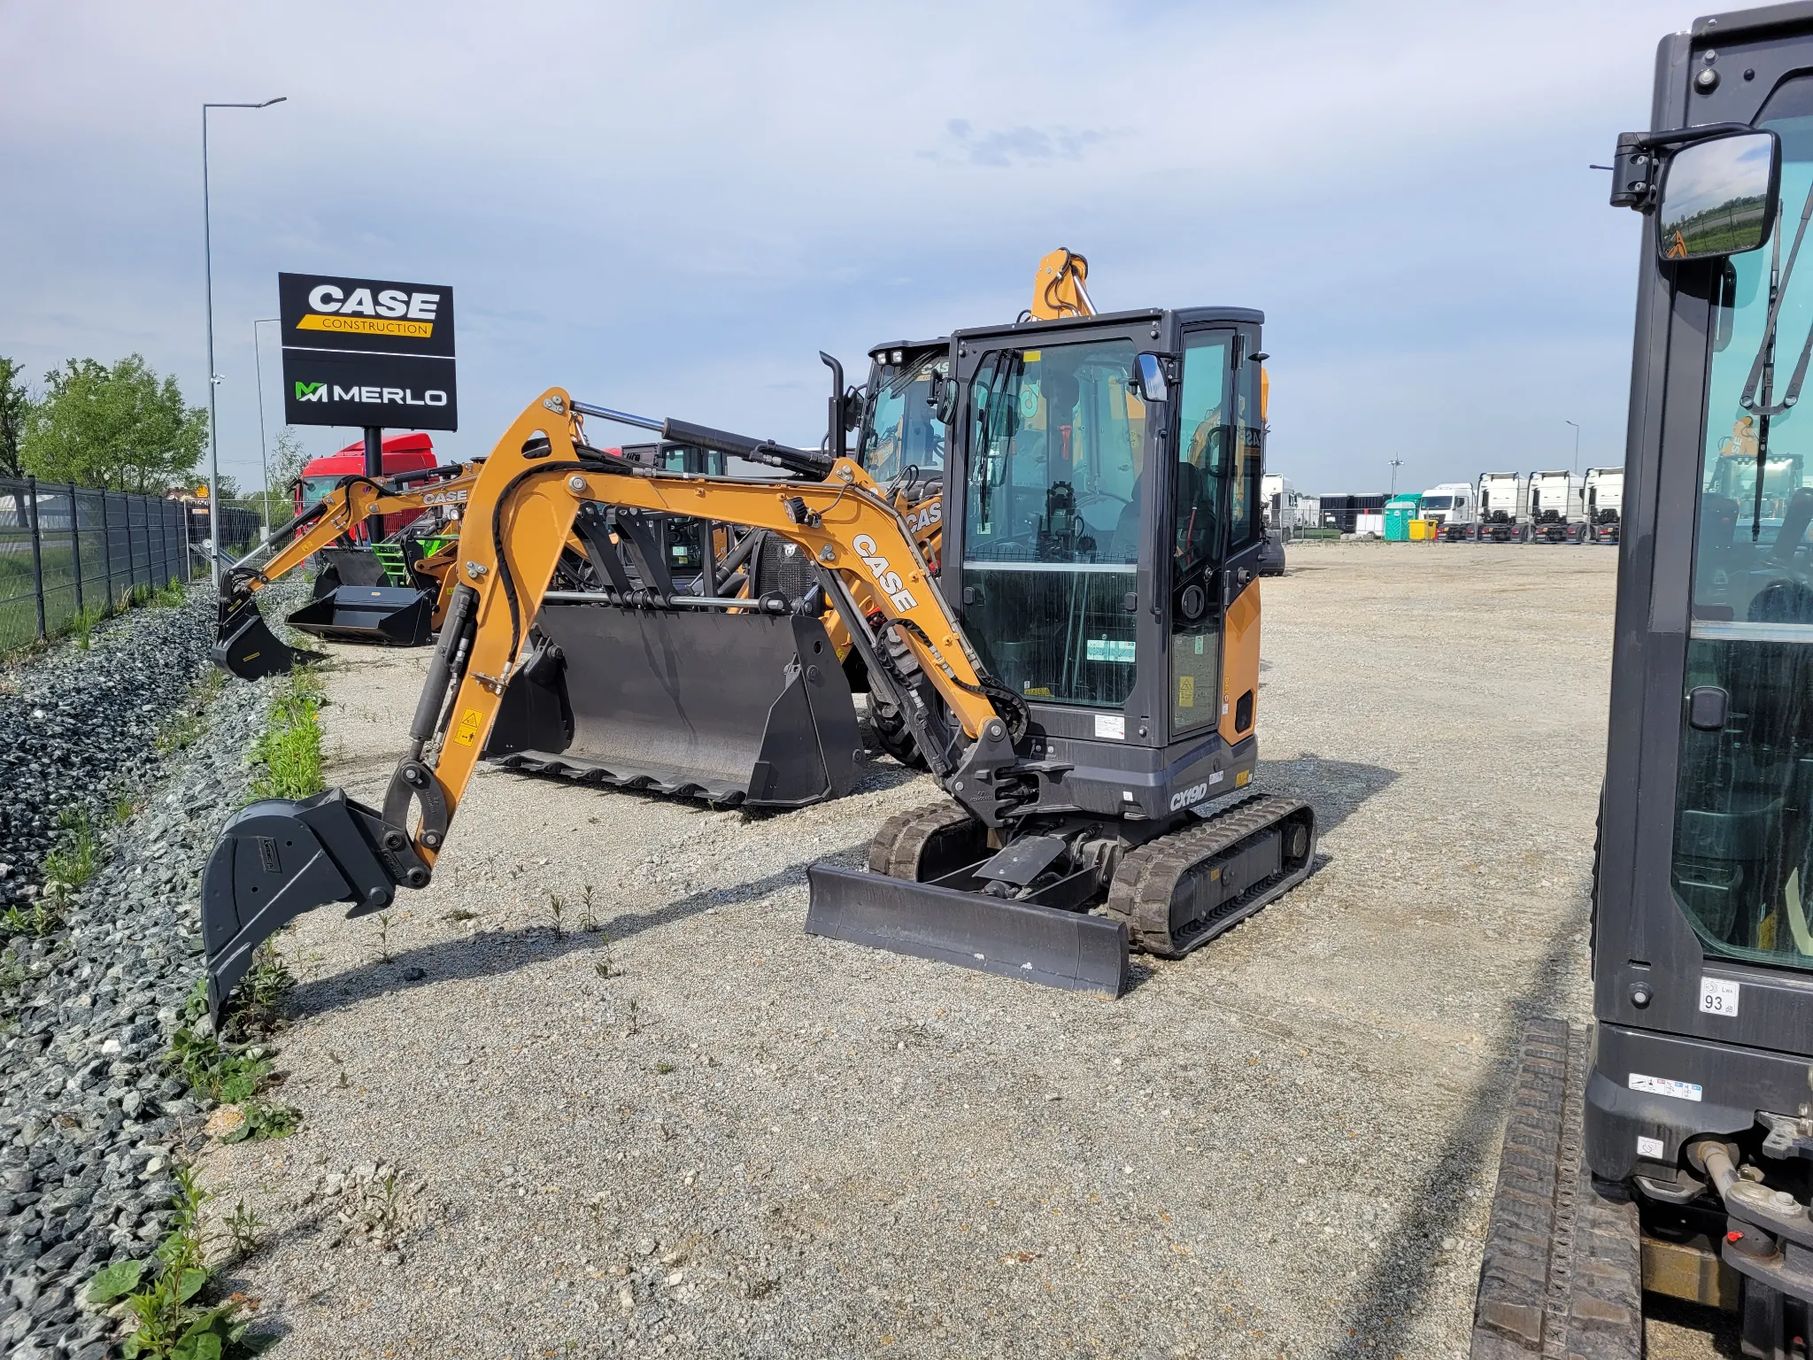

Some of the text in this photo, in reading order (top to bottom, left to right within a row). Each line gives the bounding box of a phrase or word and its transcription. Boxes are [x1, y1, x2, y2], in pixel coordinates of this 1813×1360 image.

[308, 284, 440, 320] CASE
[322, 318, 428, 335] CONSTRUCTION
[921, 361, 949, 375] CAS
[333, 385, 447, 407] MERLO
[423, 490, 467, 505] CASE
[906, 502, 941, 533] CAS
[852, 533, 918, 613] CASE
[1170, 782, 1208, 812] CX19D
[1705, 994, 1722, 1010] 93
